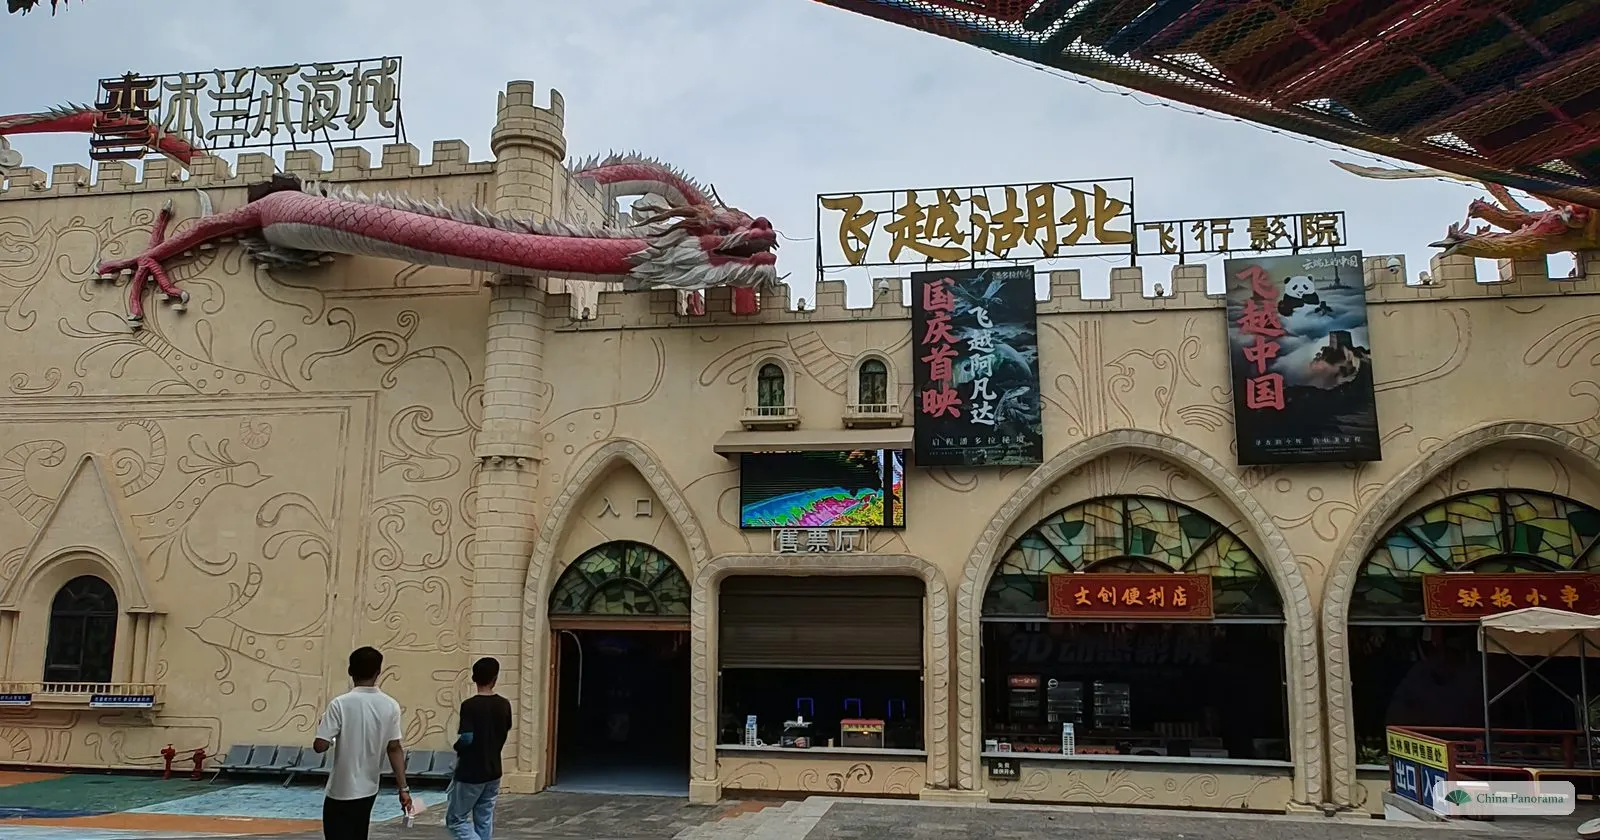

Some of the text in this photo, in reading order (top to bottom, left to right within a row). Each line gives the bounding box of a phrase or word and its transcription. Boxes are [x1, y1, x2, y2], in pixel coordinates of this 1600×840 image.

[159, 56, 398, 140] 木兰不夜城
[820, 183, 1134, 265] 飞越湖北
[1142, 213, 1341, 254] 飞行影院
[921, 277, 962, 418] 国庆首映
[1235, 264, 1285, 411] 飞越中国
[967, 306, 997, 425] 飞越阿凡达
[597, 497, 653, 518] 入口
[777, 528, 859, 553] 售票厅
[1073, 586, 1188, 607] 文创便利店
[1456, 584, 1580, 609] 铁板小串
[1395, 760, 1417, 794] 出口
